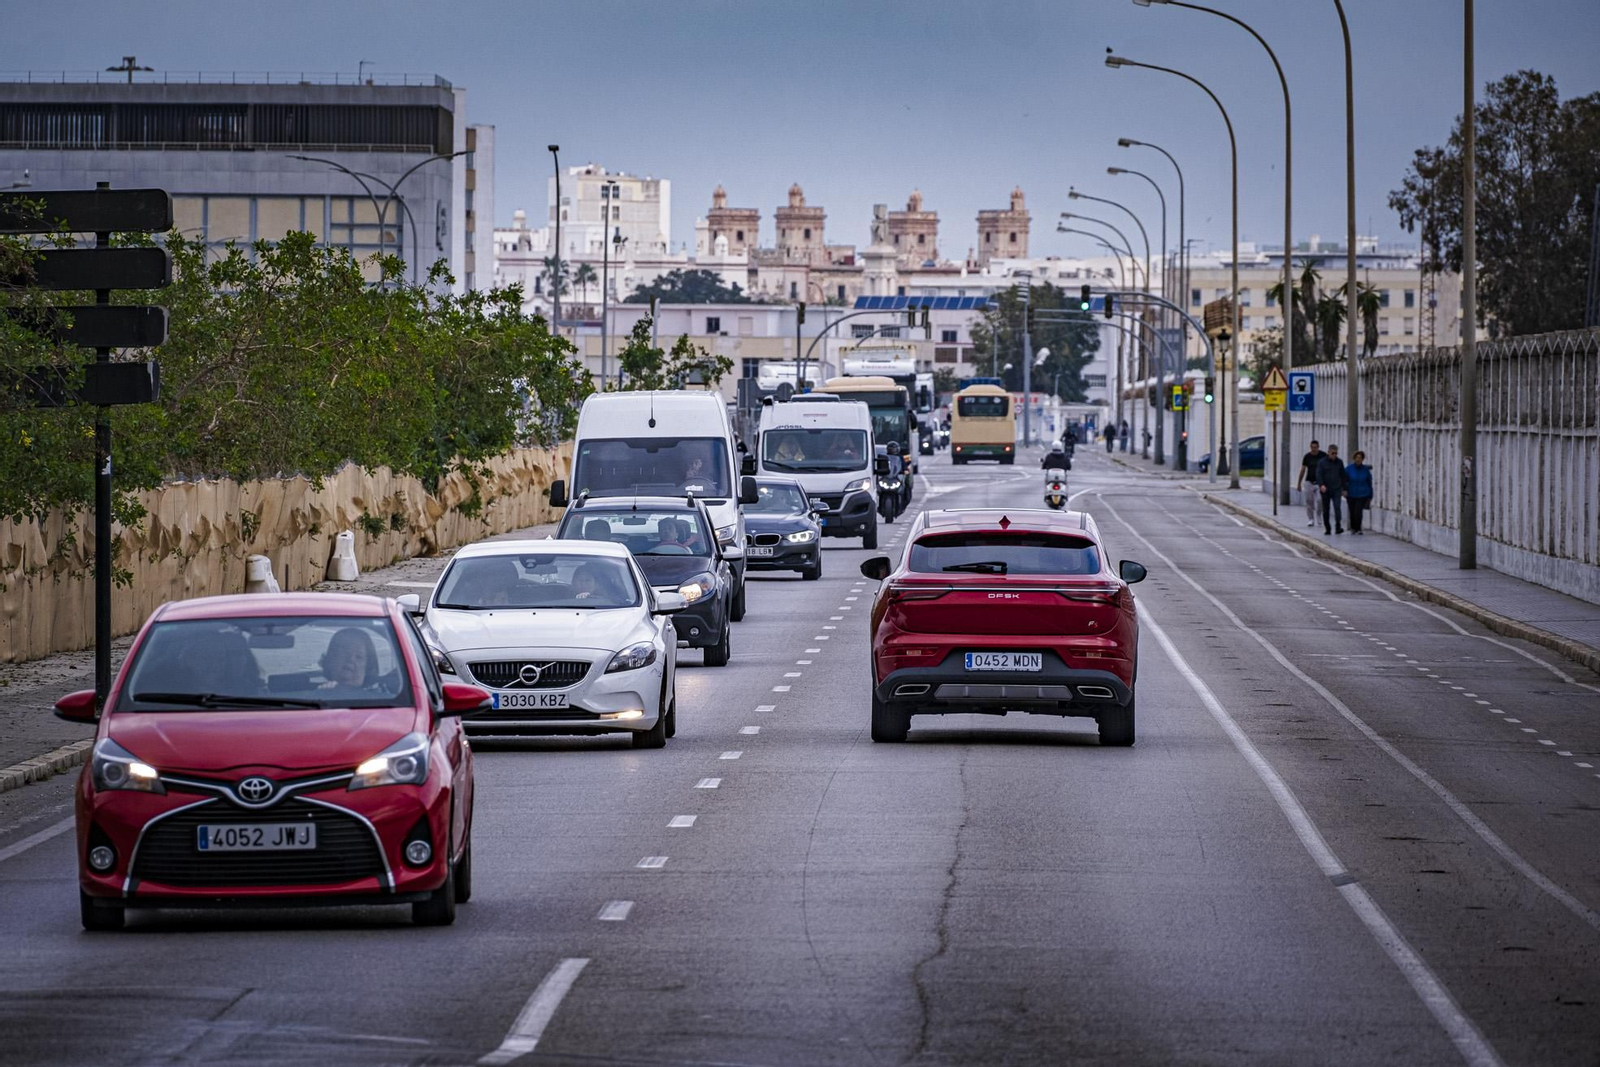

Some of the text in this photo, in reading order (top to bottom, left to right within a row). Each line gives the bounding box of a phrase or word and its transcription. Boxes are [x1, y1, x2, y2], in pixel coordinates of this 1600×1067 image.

[974, 655, 1039, 667] 0452 MDN
[502, 694, 566, 707] 3030 KBZ
[212, 826, 310, 847] 4052 JWJ
